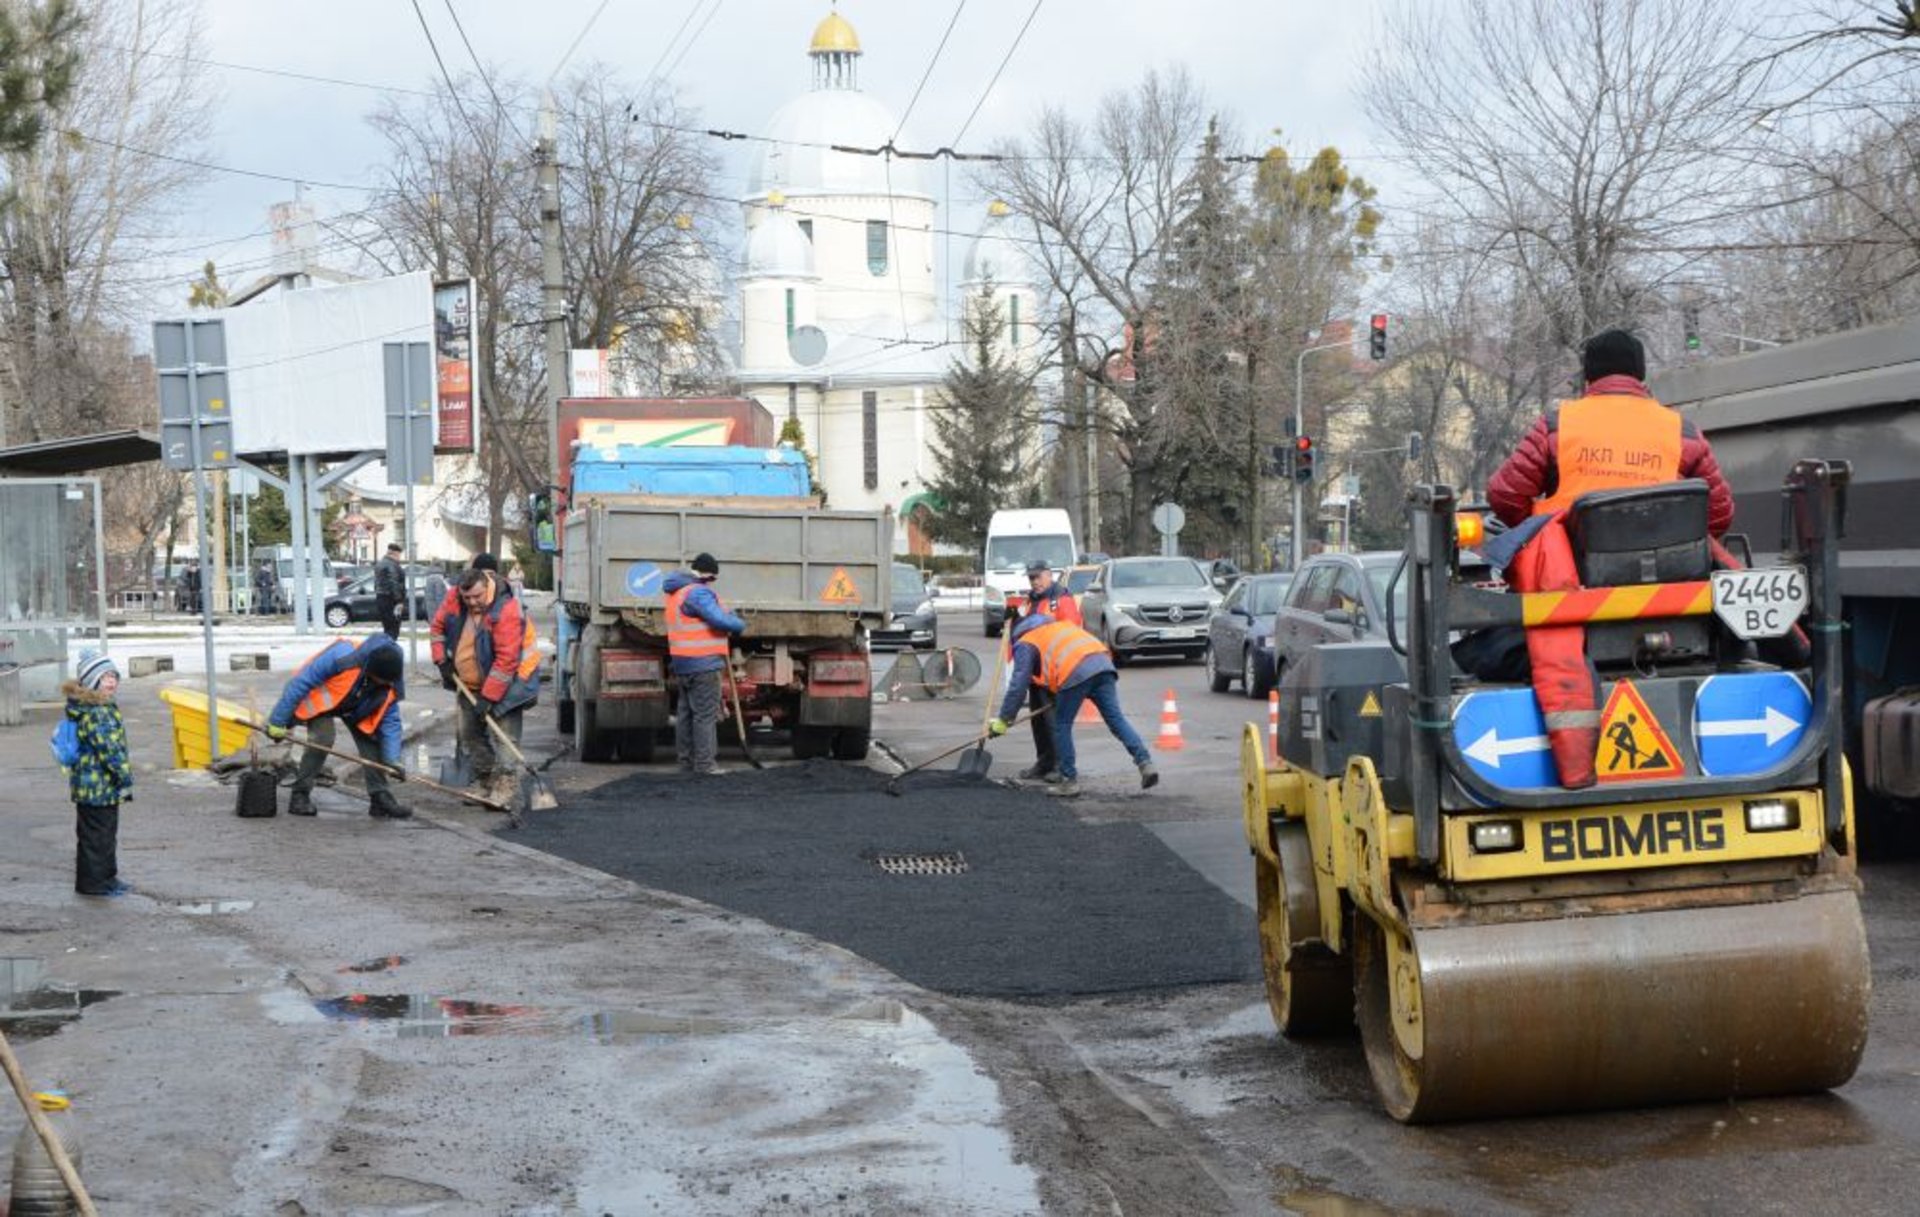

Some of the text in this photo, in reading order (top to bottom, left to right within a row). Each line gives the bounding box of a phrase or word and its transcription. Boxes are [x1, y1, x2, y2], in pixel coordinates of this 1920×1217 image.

[1577, 448, 1662, 468] ЛКП ШРП
[1719, 573, 1802, 605] 24466
[1745, 609, 1779, 630] BC
[1541, 809, 1725, 862] BOMAG
